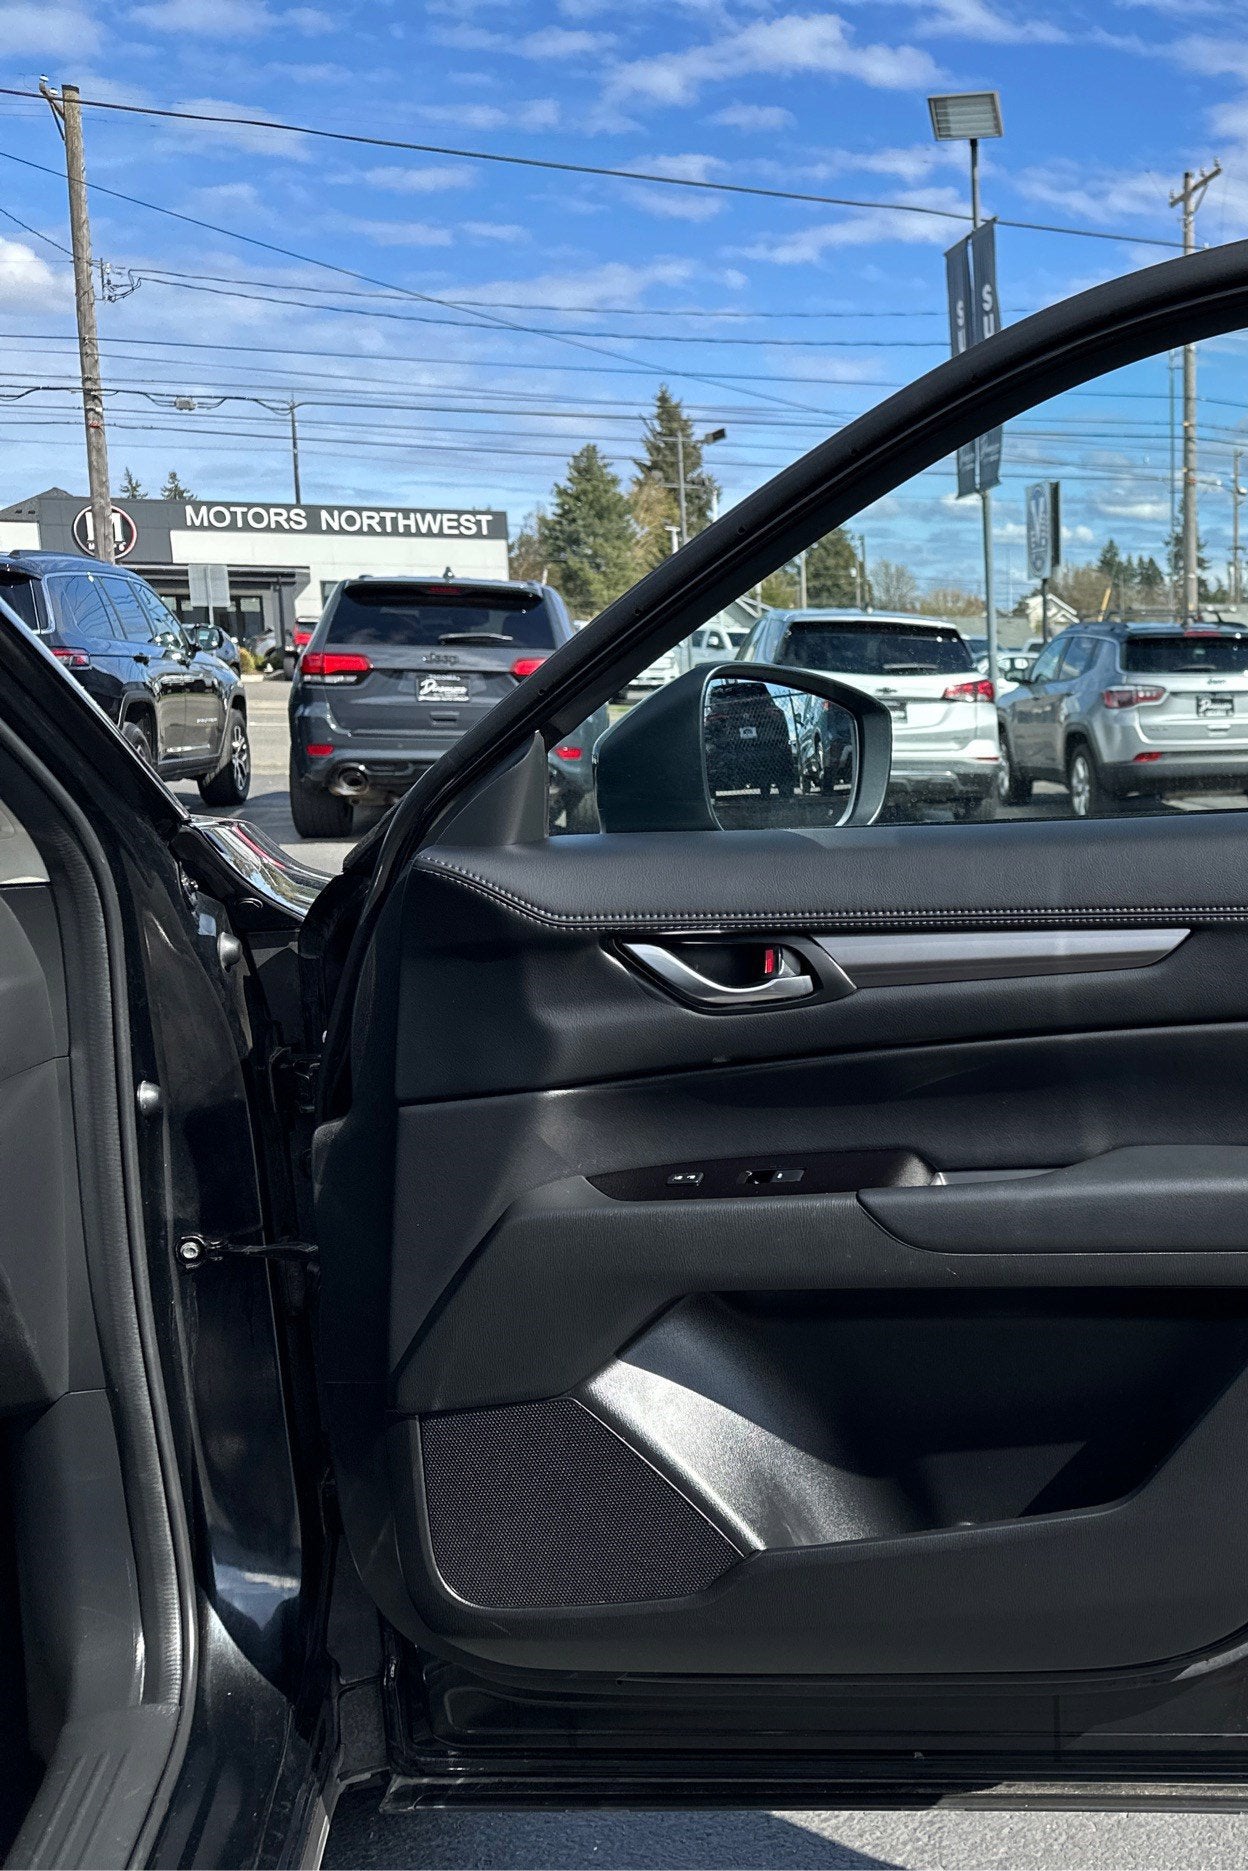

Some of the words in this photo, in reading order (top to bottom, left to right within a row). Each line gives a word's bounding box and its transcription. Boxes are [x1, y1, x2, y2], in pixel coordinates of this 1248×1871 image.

[184, 504, 308, 530] MOTORS
[320, 509, 494, 536] NORTHWEST
[422, 651, 460, 667] Jeep
